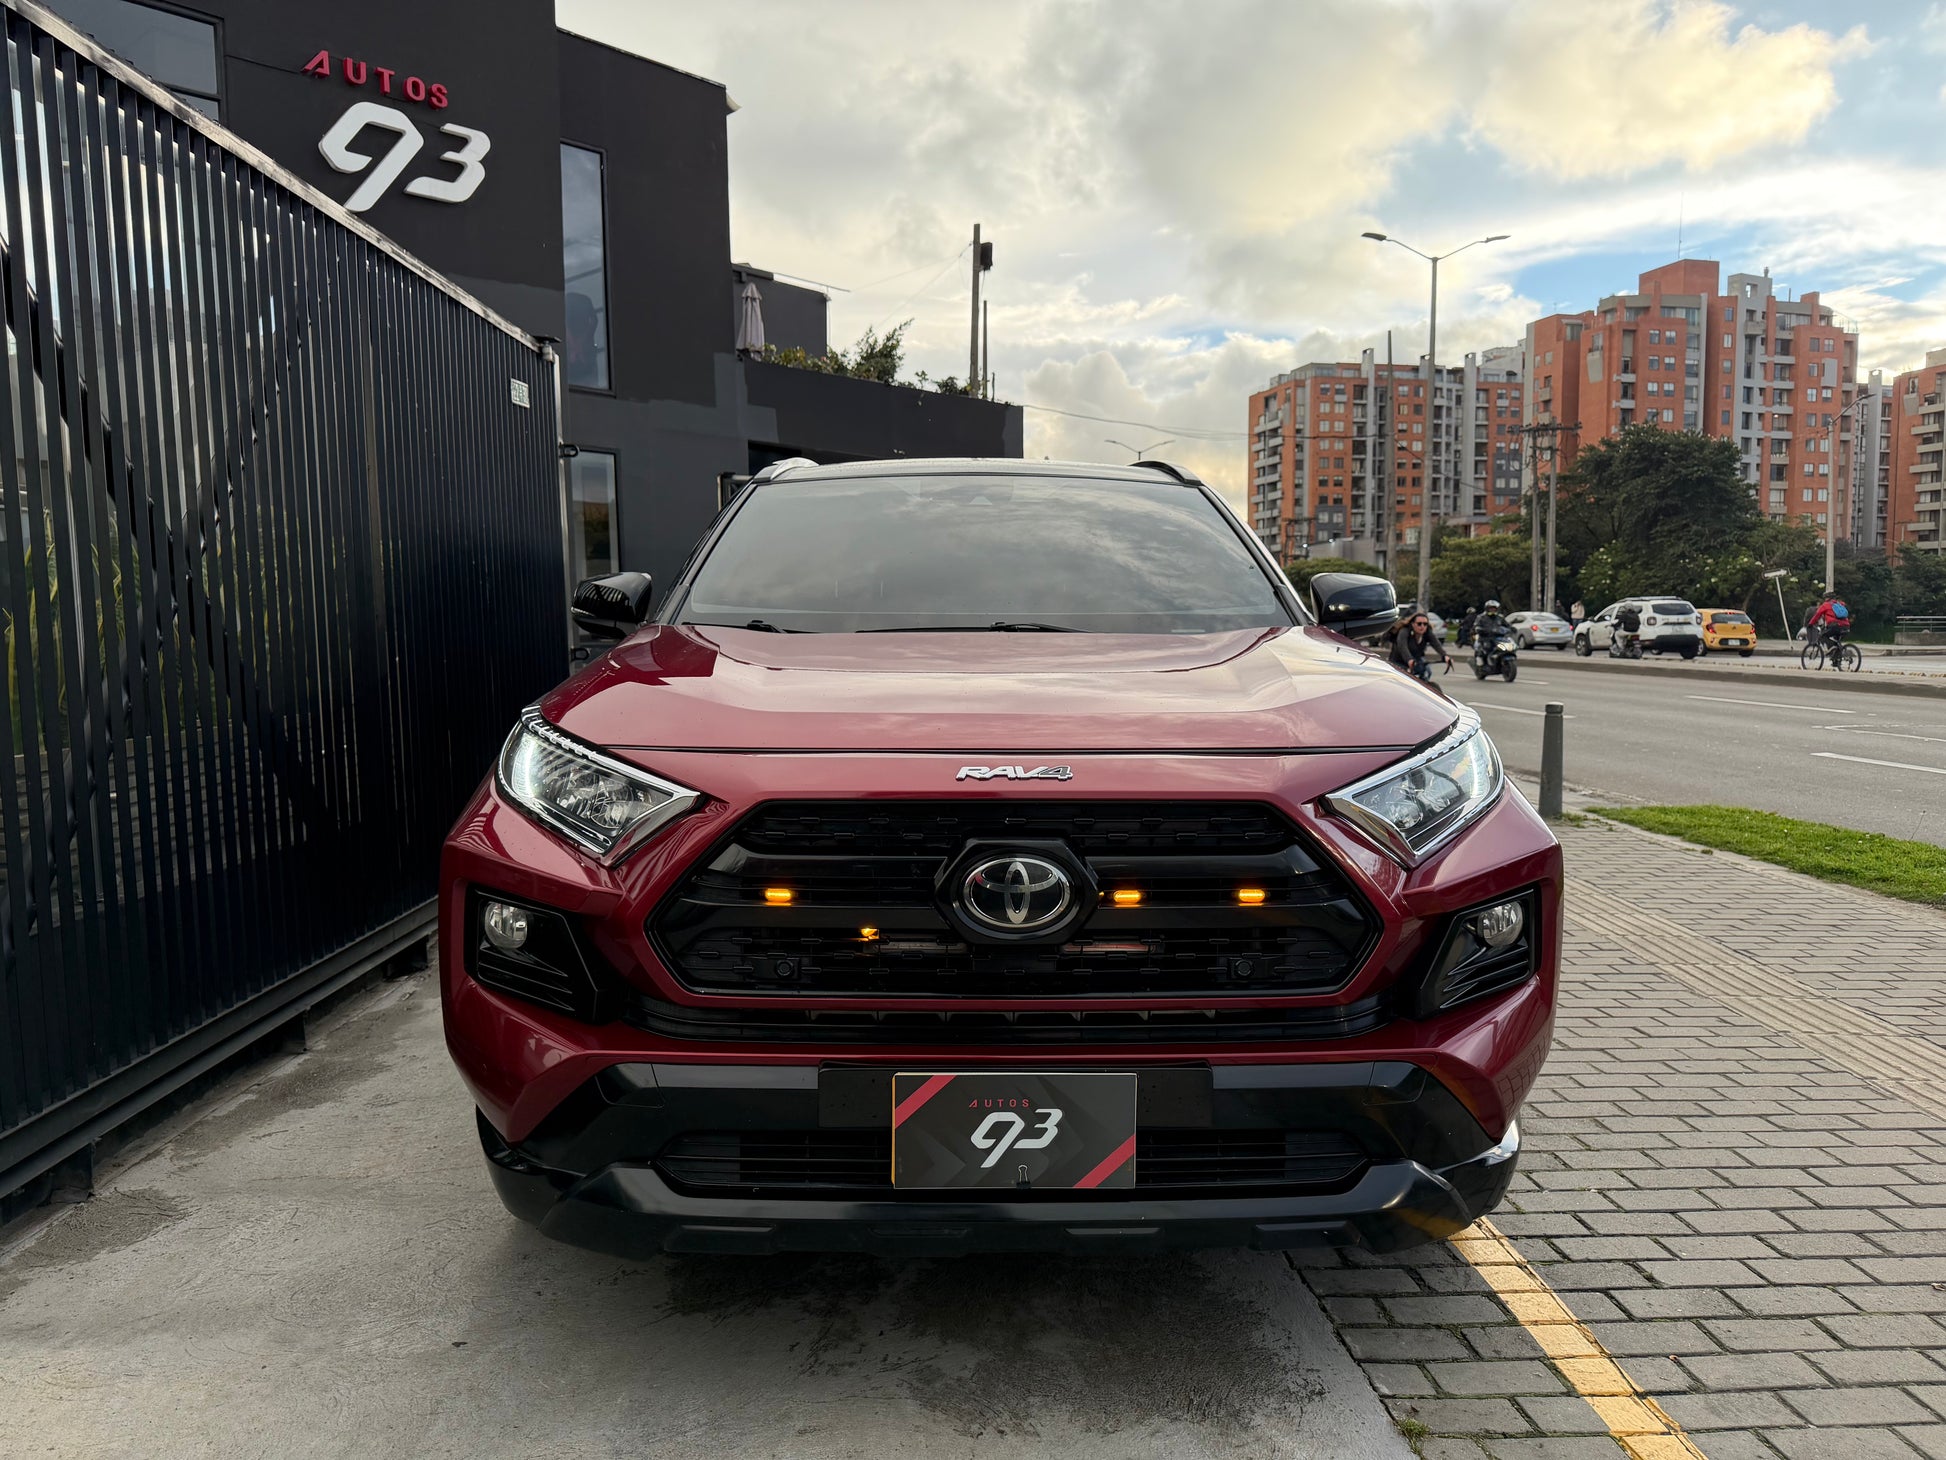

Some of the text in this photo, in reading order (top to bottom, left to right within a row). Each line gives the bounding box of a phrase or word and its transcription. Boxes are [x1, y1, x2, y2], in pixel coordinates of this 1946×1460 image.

[301, 50, 448, 109] AUTOS
[318, 101, 491, 213] 93
[956, 765, 1074, 781] RAV4
[969, 1099, 1030, 1108] AUTOS
[970, 1108, 1063, 1168] 93
